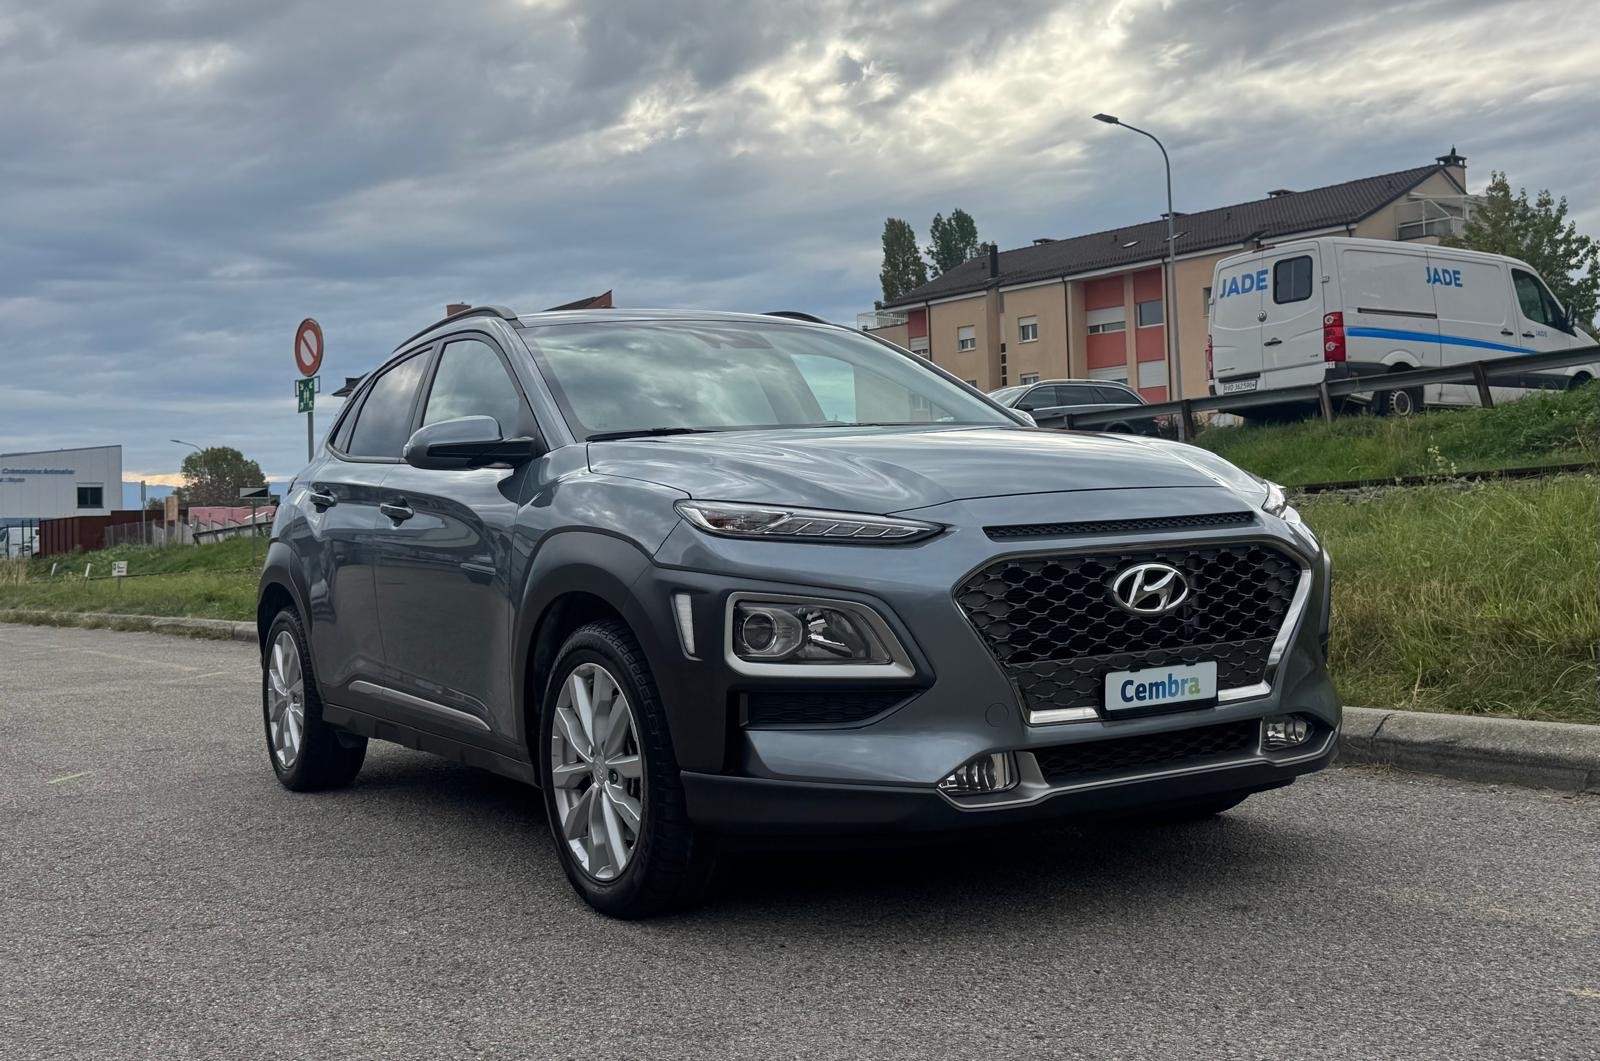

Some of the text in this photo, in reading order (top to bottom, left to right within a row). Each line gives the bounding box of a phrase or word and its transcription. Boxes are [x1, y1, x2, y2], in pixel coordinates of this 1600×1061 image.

[1220, 269, 1268, 299] JADE
[1426, 267, 1463, 287] JADE
[1121, 673, 1201, 702] Cembra
